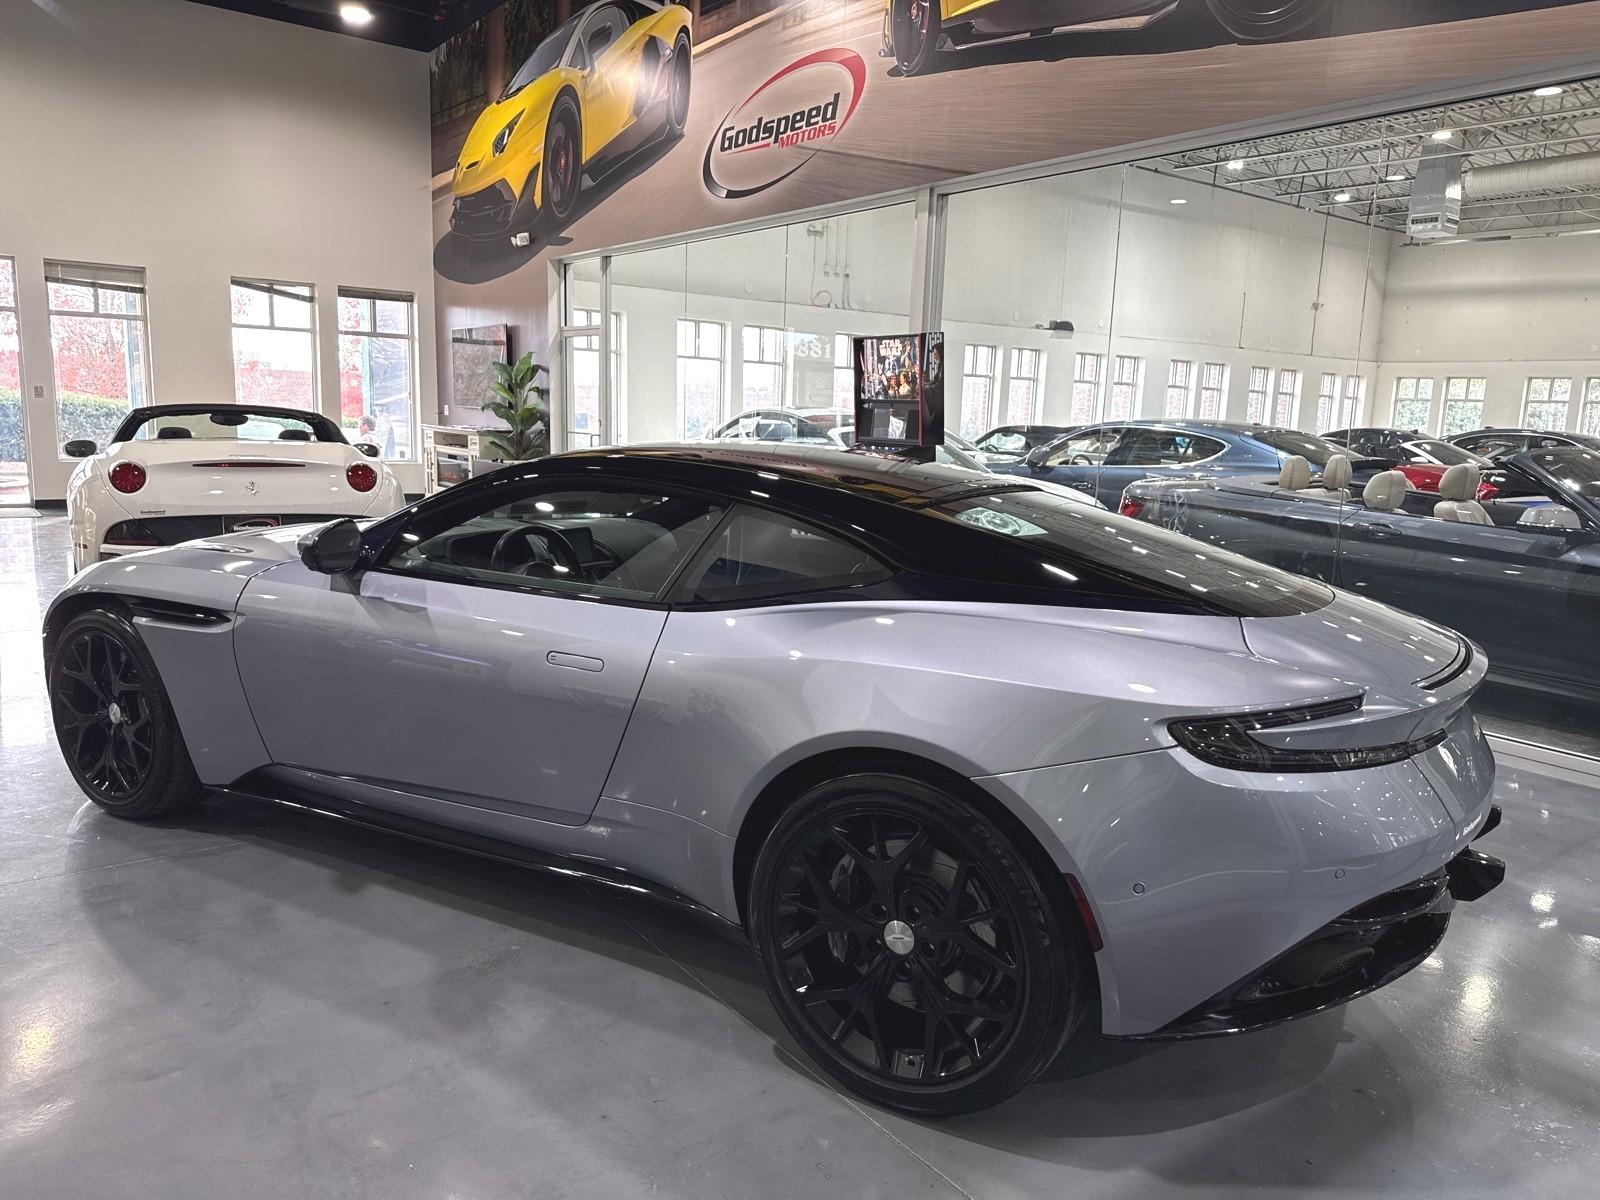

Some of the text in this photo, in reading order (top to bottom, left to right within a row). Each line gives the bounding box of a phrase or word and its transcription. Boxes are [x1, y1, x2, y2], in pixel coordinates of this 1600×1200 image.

[720, 92, 840, 152] Godspeed
[778, 121, 837, 149] MOTORS
[879, 346, 902, 356] WARS
[881, 339, 902, 348] STAR
